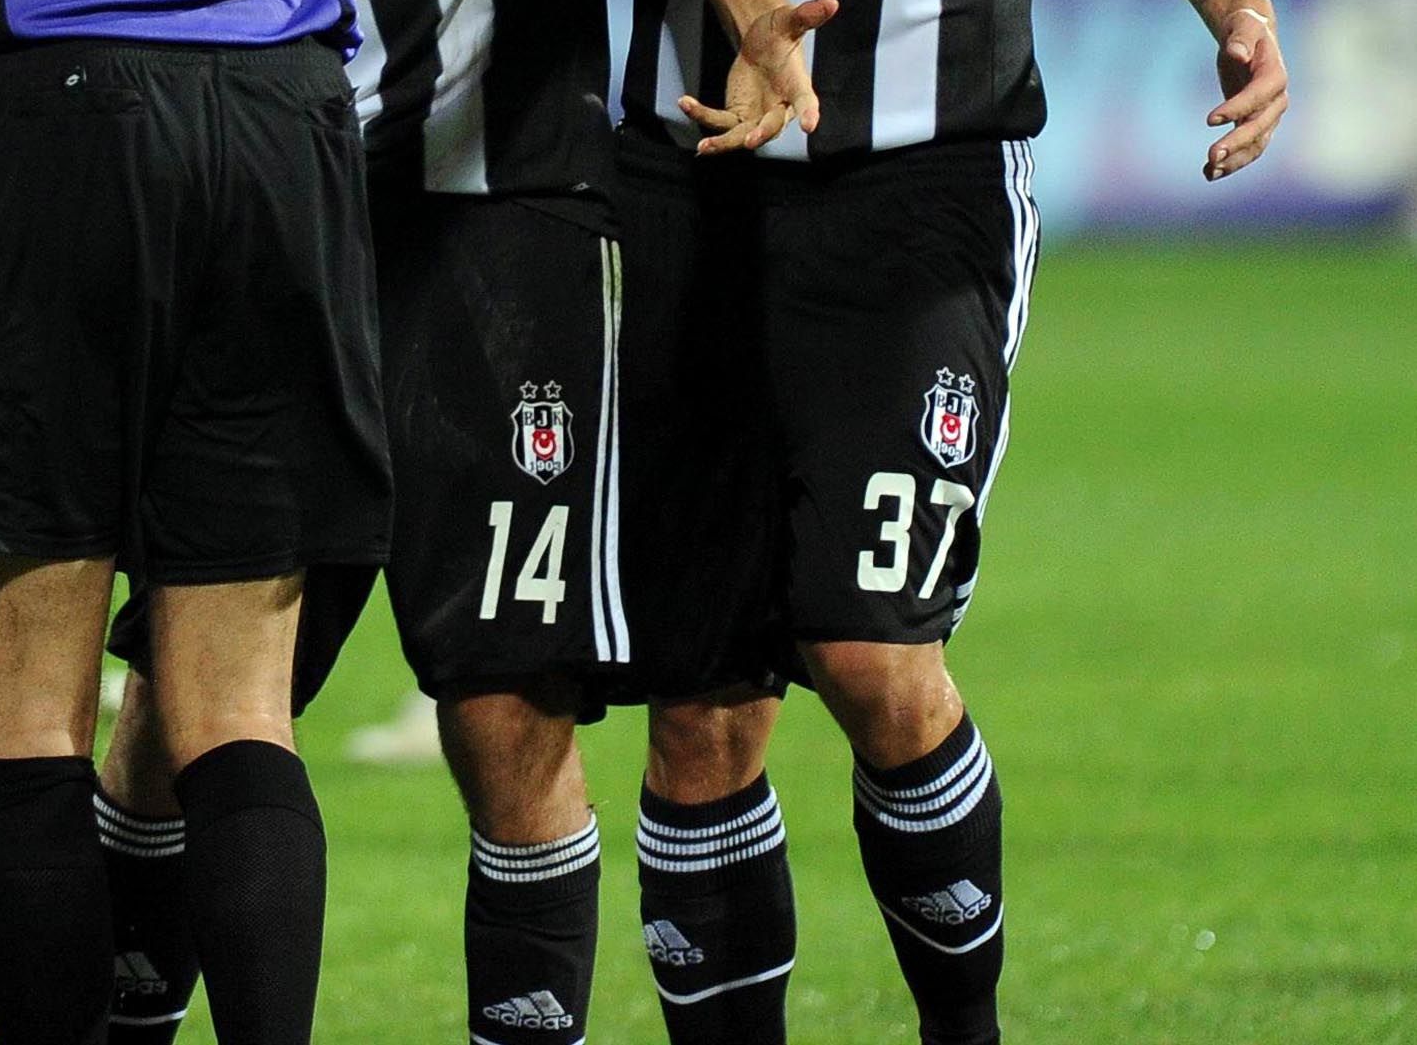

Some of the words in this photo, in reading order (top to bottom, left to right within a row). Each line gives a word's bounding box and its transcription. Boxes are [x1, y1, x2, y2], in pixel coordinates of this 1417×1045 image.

[529, 460, 562, 476] 1903
[479, 501, 570, 624] 14
[857, 471, 975, 599] 37
[482, 1006, 574, 1031] adidas
